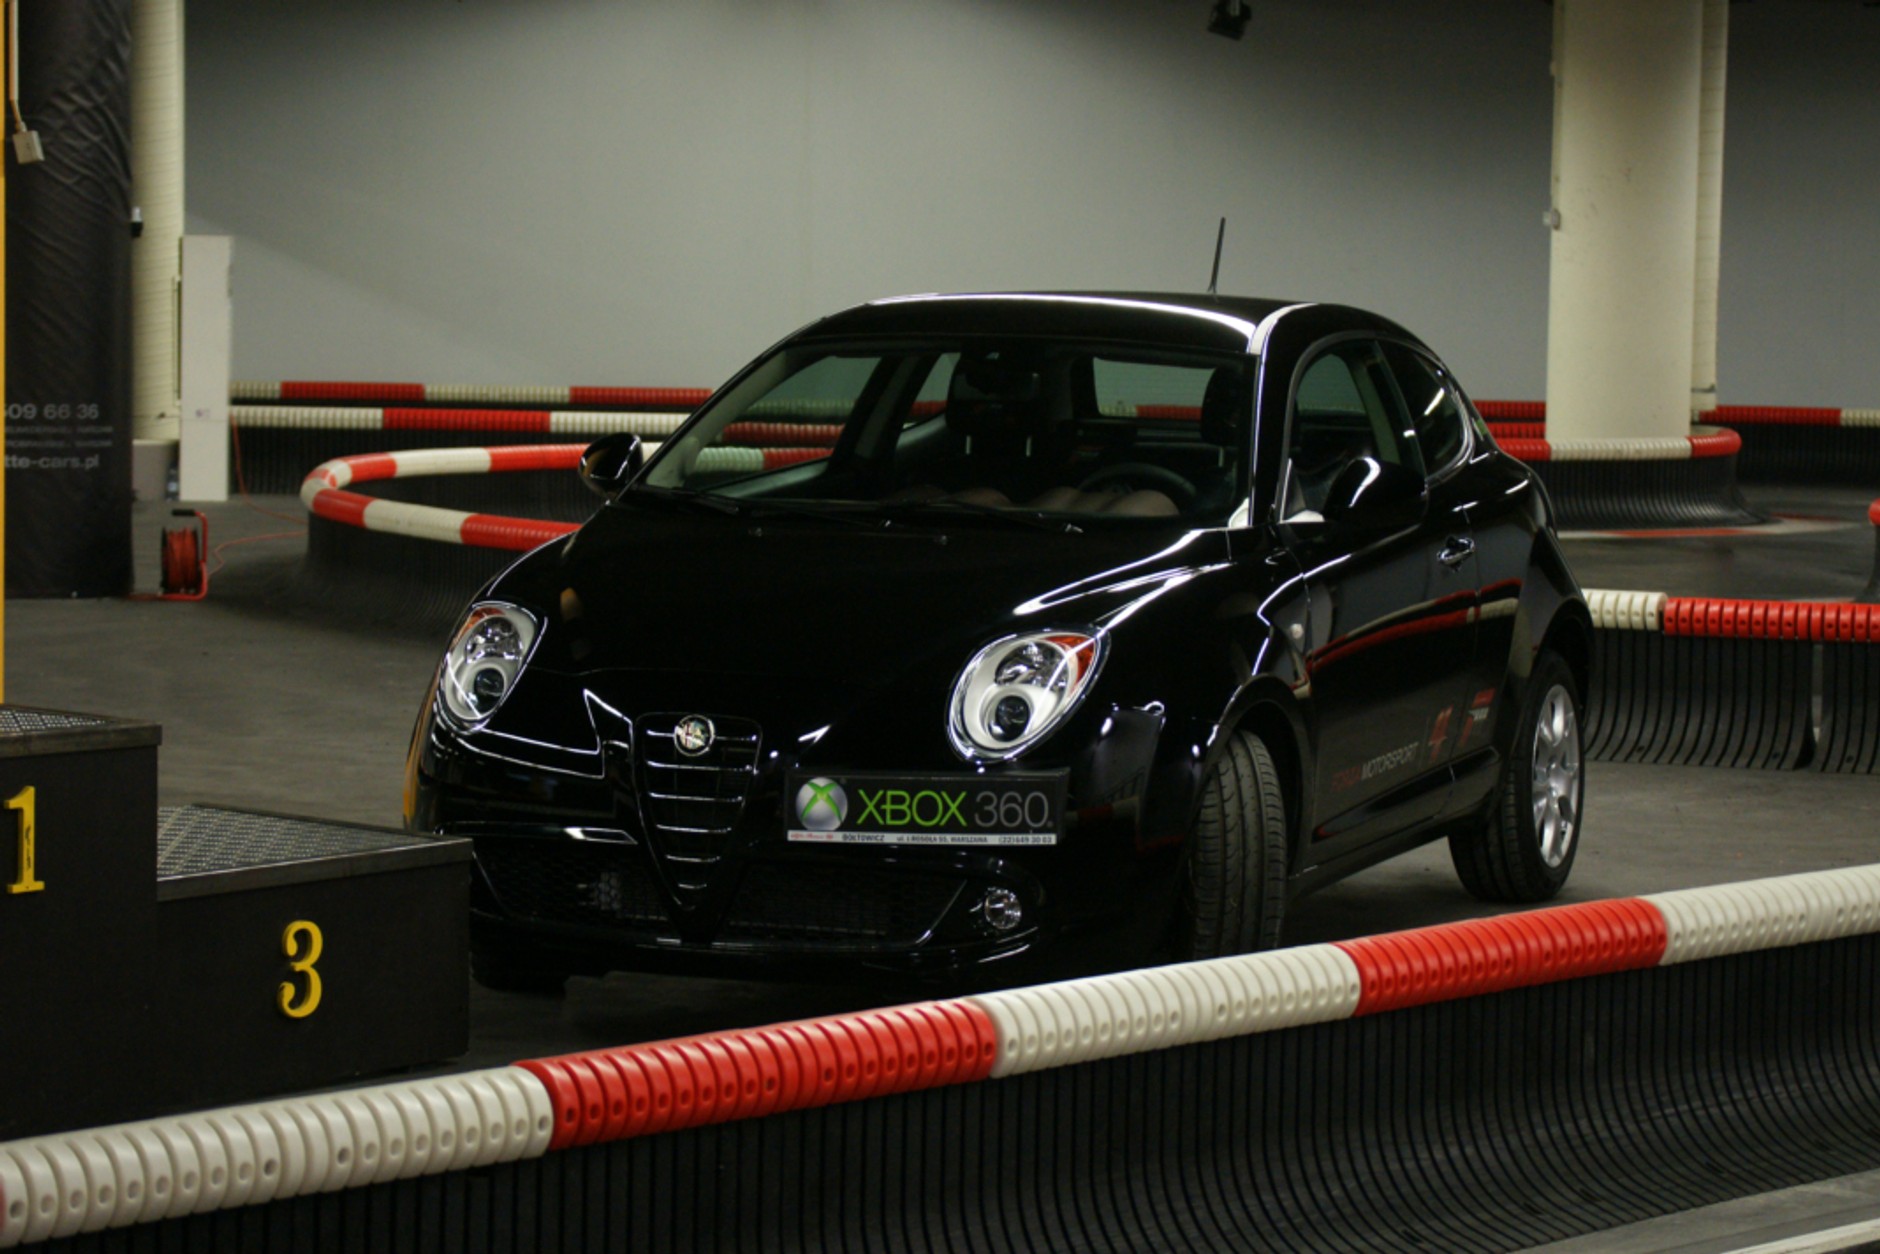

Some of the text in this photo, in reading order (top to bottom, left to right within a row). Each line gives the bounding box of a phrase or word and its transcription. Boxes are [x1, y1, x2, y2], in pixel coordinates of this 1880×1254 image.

[5, 402, 100, 420] 09 66 36
[3, 785, 45, 893] 1
[856, 788, 1048, 828] XBOX 360
[277, 920, 324, 1018] 3
